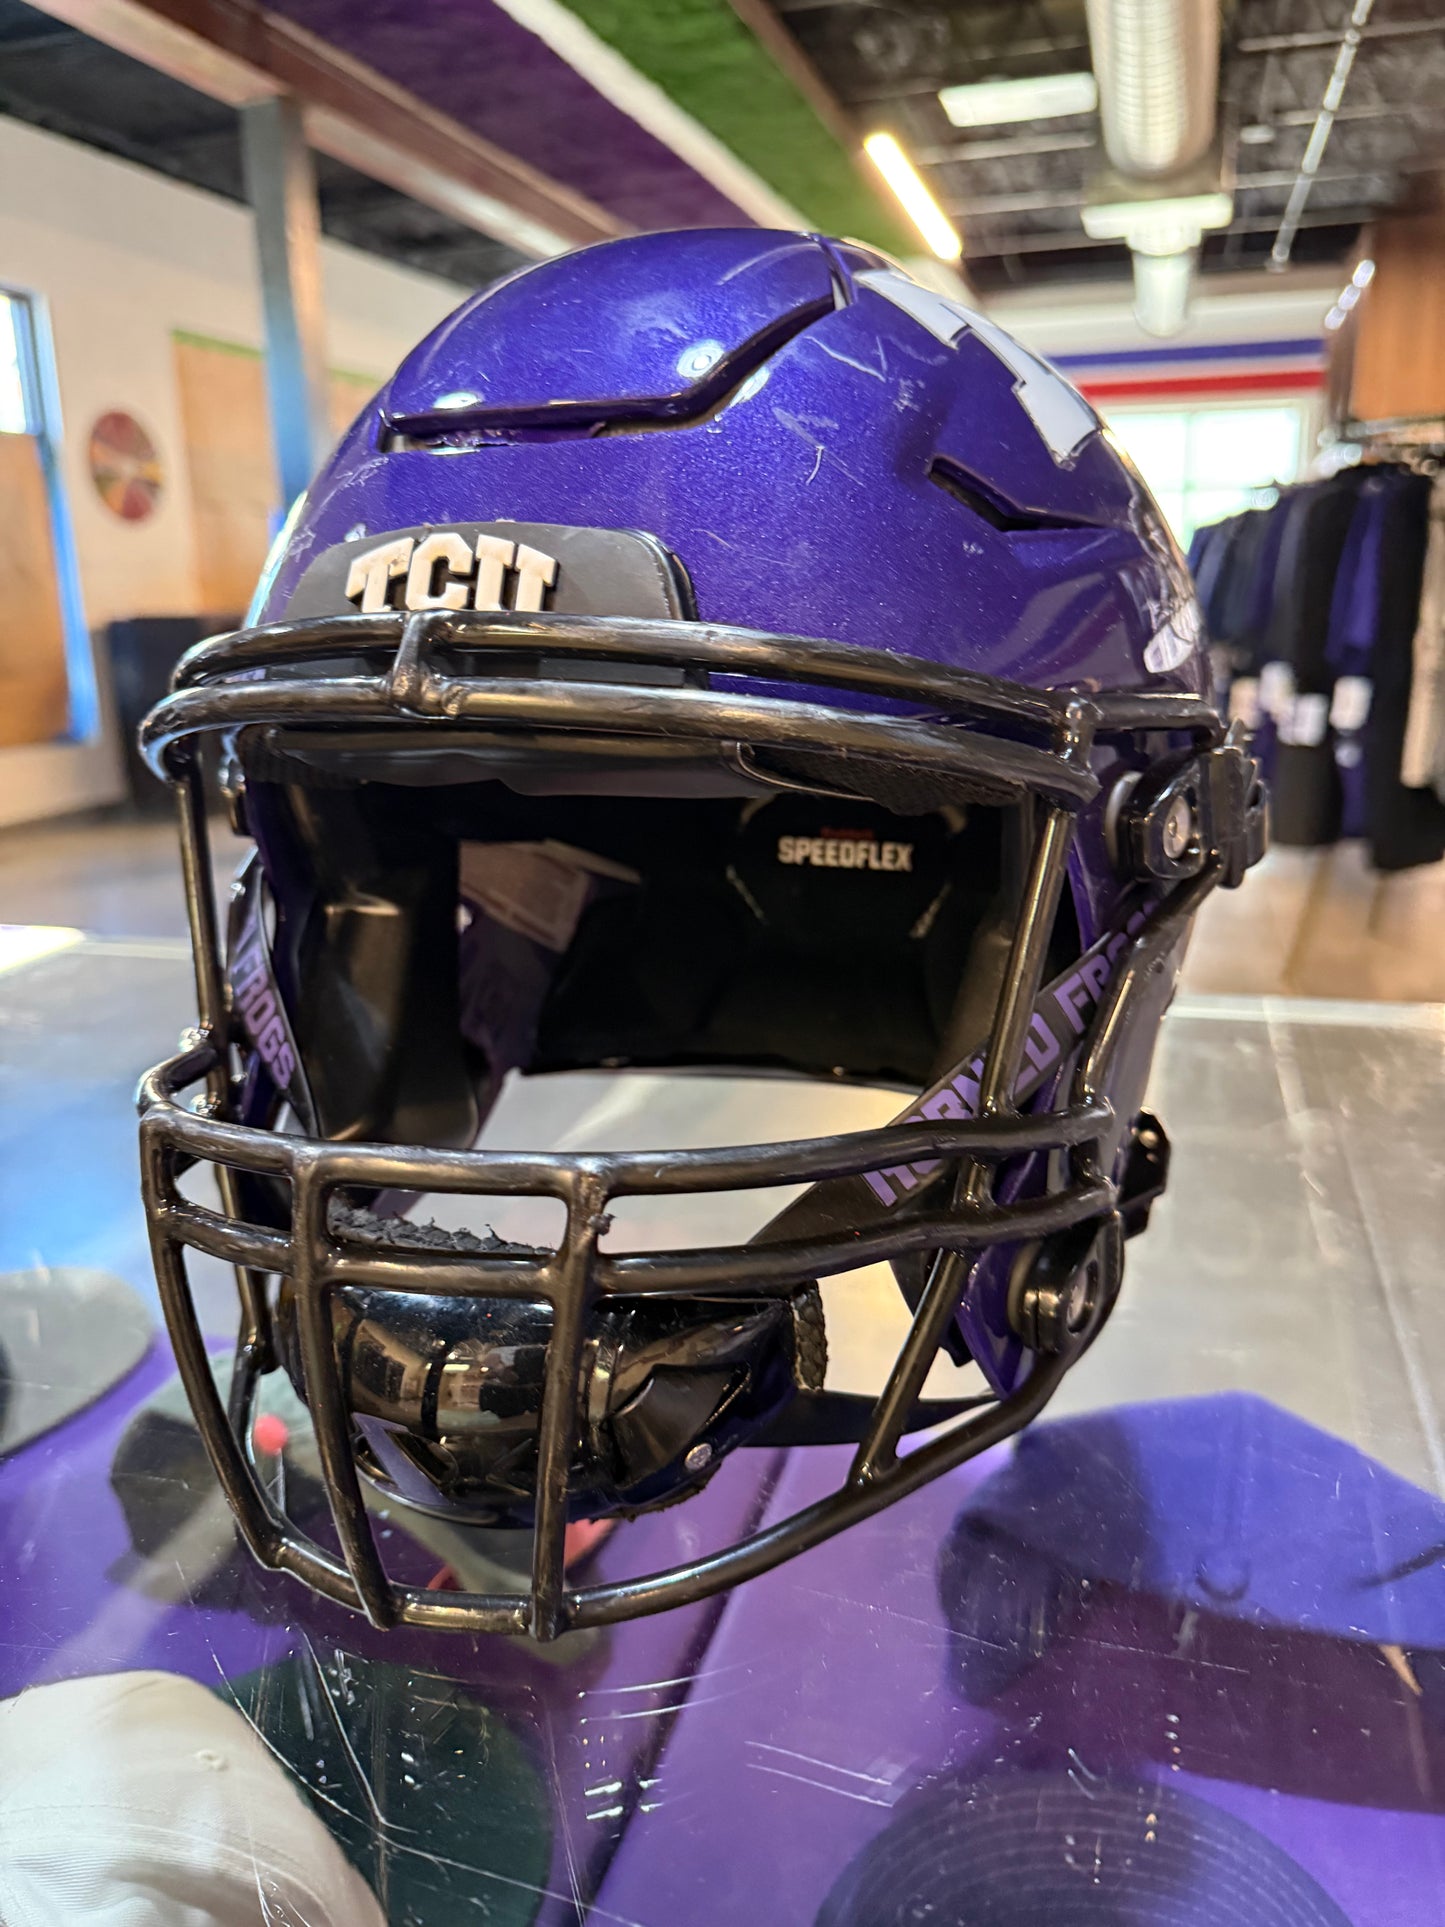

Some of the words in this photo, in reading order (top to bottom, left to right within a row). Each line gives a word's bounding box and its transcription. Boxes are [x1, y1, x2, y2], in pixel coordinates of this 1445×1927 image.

[345, 533, 556, 613] TCU
[777, 836, 913, 872] SPEEDFLEX
[862, 1012, 1061, 1207] HRND
